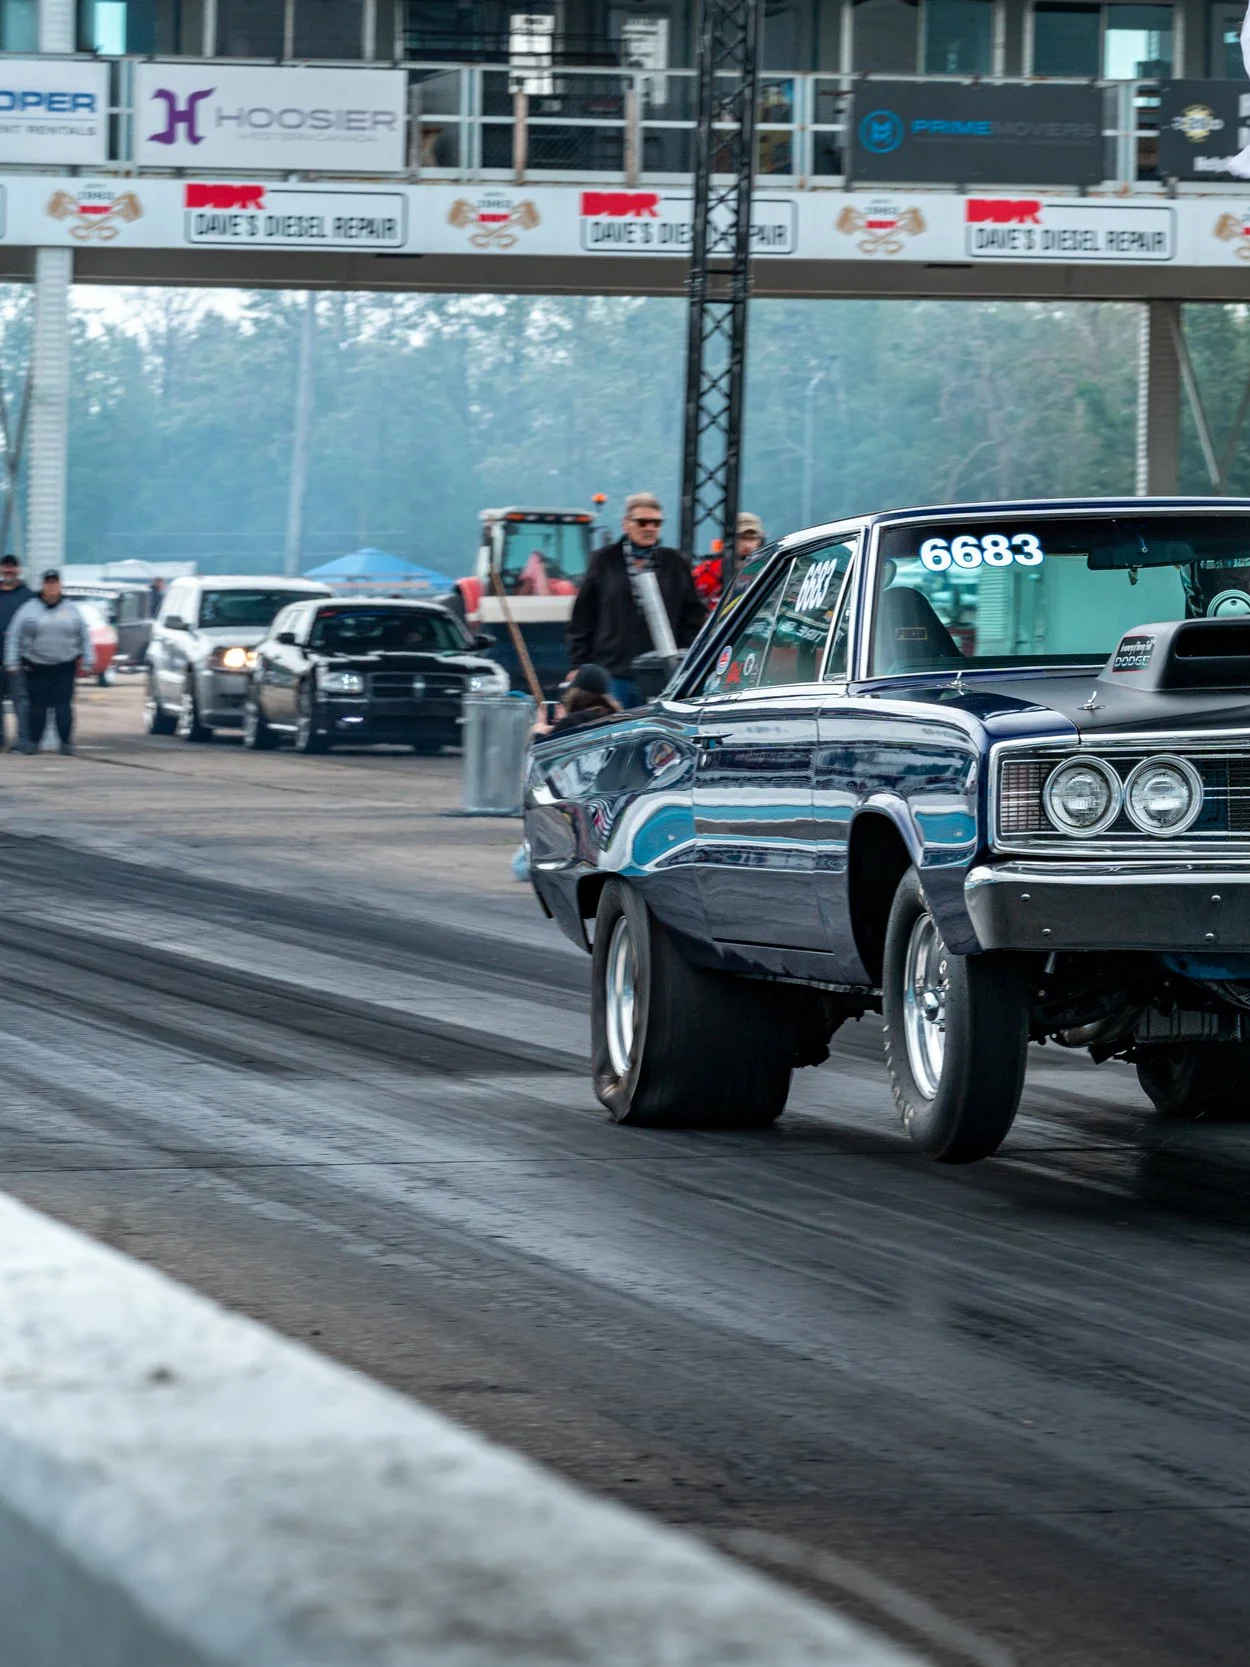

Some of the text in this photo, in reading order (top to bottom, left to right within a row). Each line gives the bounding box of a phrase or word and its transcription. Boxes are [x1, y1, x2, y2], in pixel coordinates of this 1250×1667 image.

[215, 106, 398, 132] HOOSIER
[195, 214, 398, 239] DAVE'S DIESEL REPAIR
[591, 222, 654, 244] DAVE'S
[975, 228, 1167, 252] DAVE'S DIESEL REPAIR
[920, 533, 1044, 572] 6683
[794, 558, 838, 613] 6683
[1114, 655, 1151, 667] DODGE
